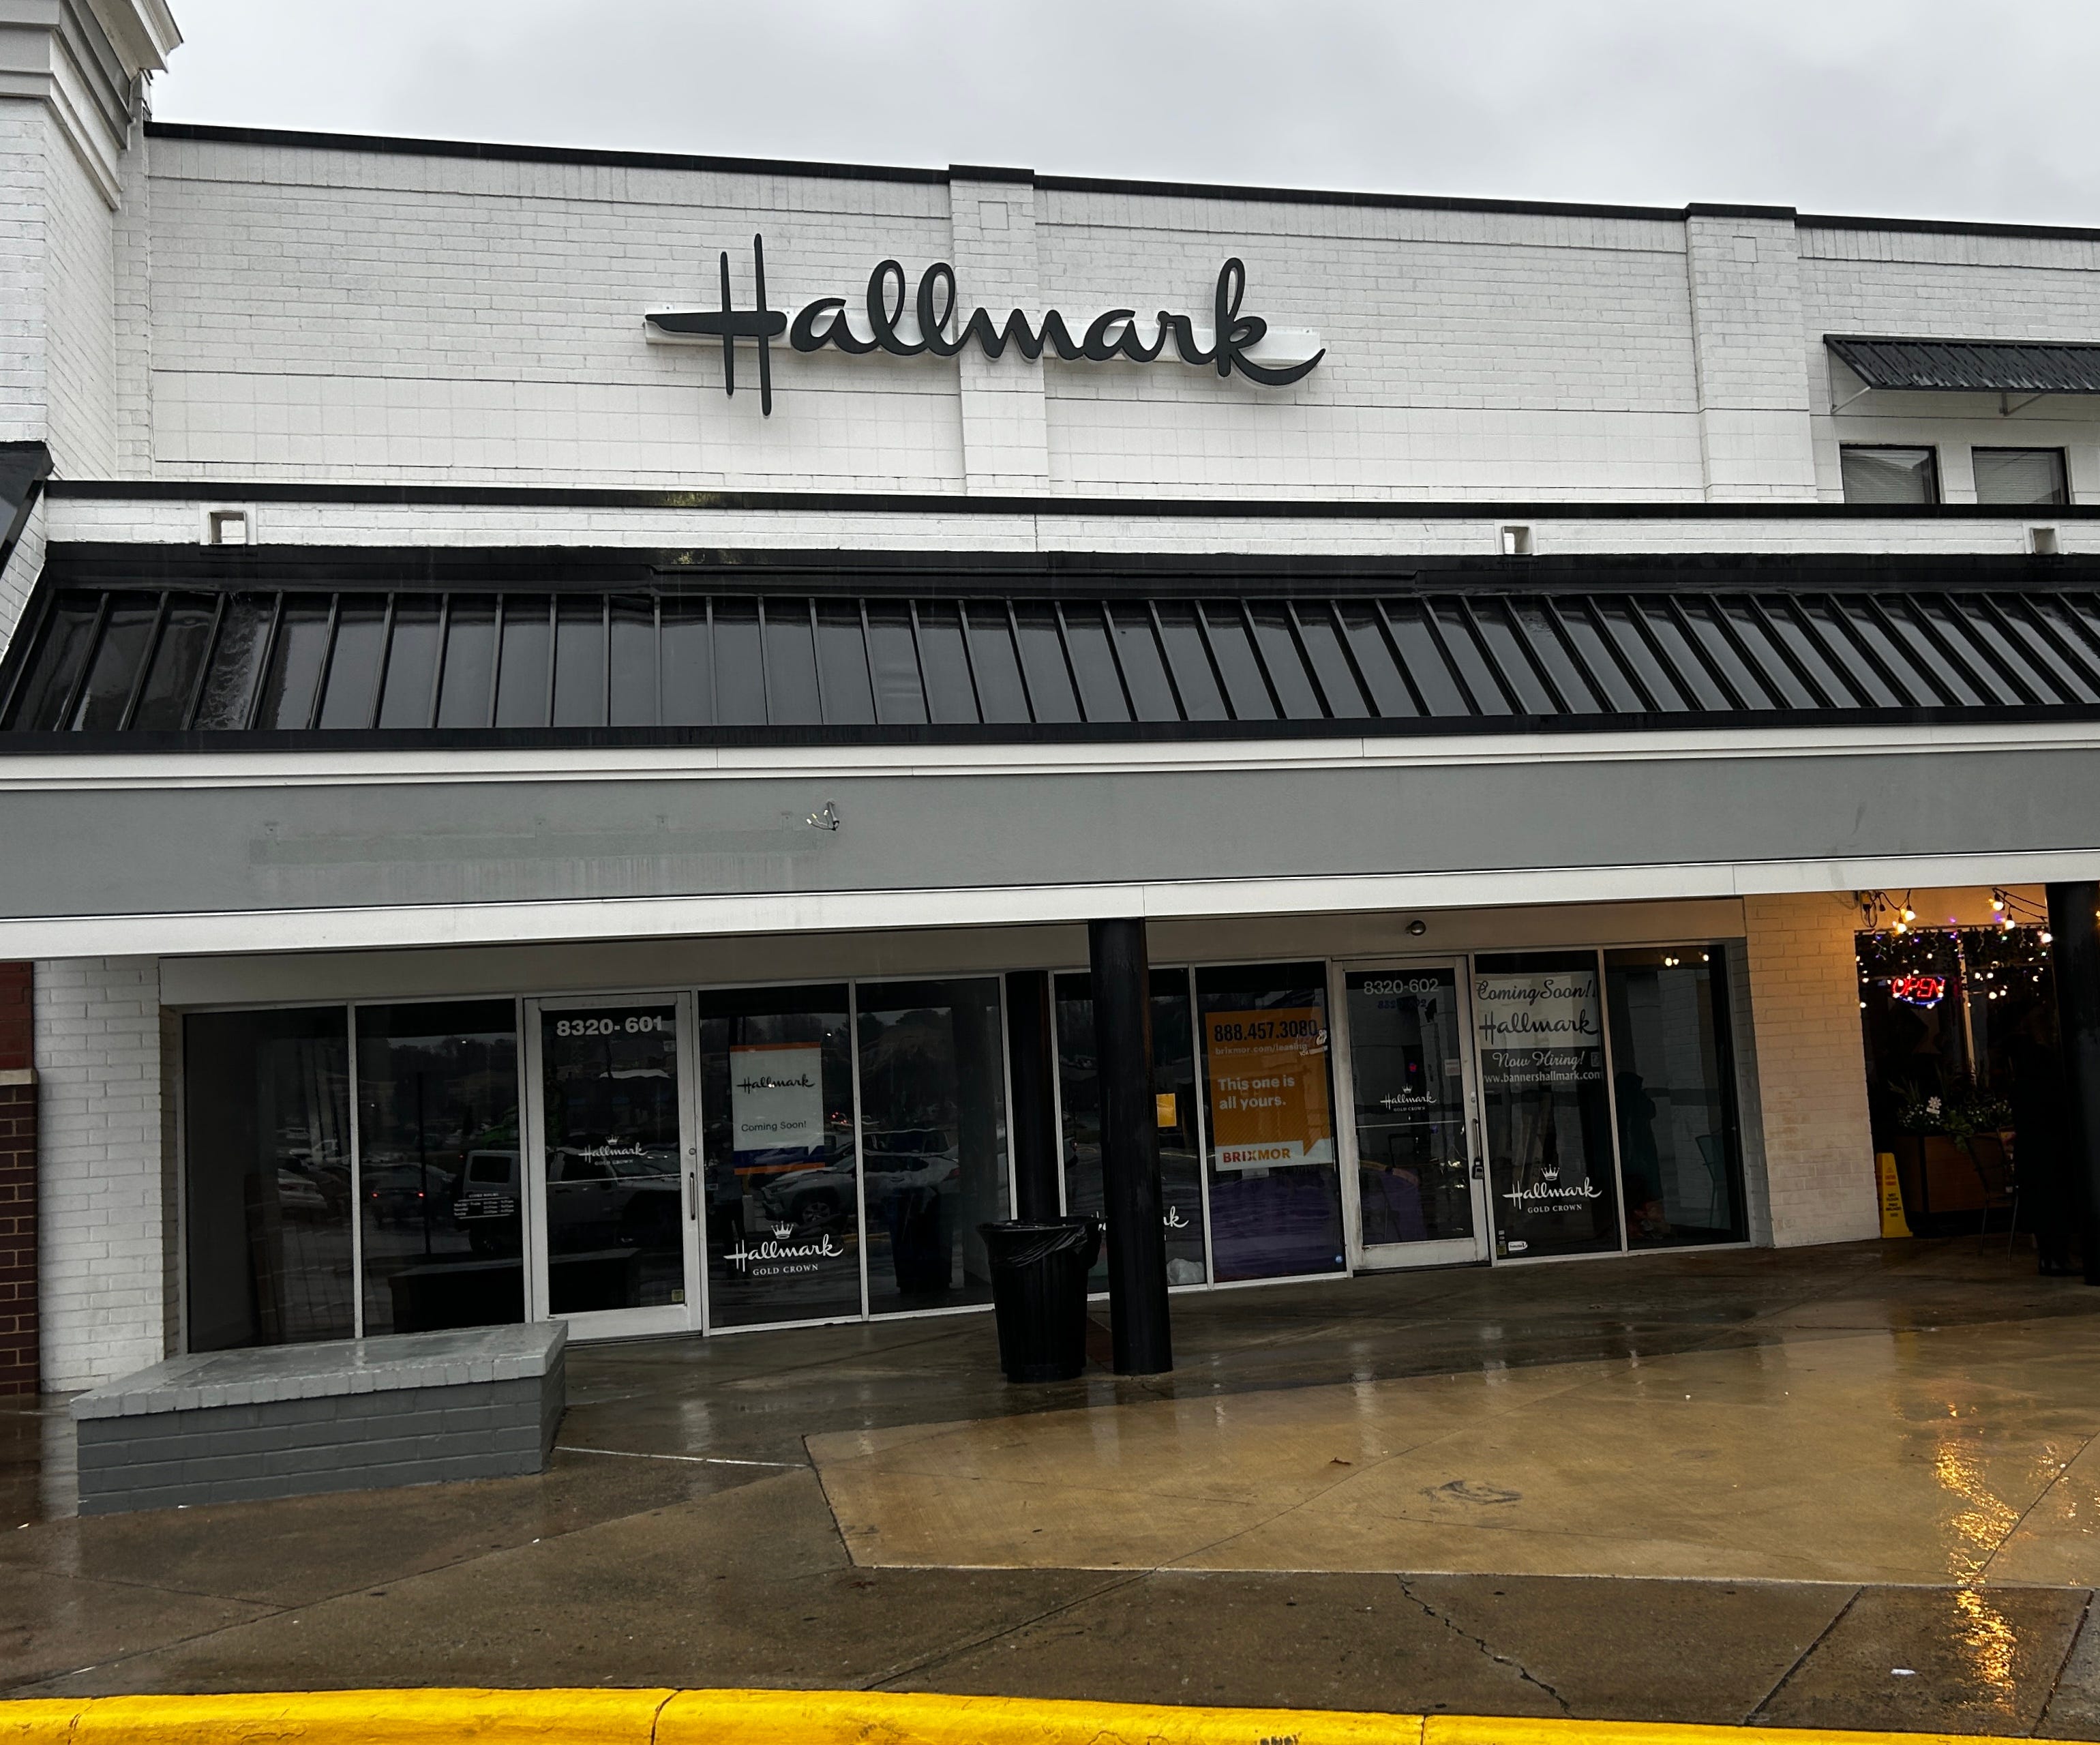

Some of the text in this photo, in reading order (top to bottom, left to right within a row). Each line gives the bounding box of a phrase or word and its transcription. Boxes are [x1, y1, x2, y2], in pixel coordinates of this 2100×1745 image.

[645, 233, 1325, 416] Hallmark
[1364, 979, 1439, 995] 8320-602
[1475, 980, 1540, 1006] Coming
[1892, 978, 1945, 998] OPEN
[1214, 1019, 1318, 1043] 888.457.3080
[1479, 1009, 1599, 1045] Hallmark
[1492, 1050, 1585, 1070] Now Hiring!
[737, 1073, 815, 1094] Hallmark
[1218, 1075, 1295, 1091] This one is
[1219, 1095, 1287, 1112] all yours.
[1380, 1091, 1437, 1110] Hallmark
[741, 1120, 807, 1133] Coming Soon!
[578, 1142, 648, 1163] Hallmark
[1222, 1148, 1291, 1163] BRIXMOR
[1501, 1177, 1603, 1210] Hallmark
[1527, 1204, 1582, 1213] GOLD CROWN
[723, 1234, 844, 1272] Hallmark
[753, 1264, 819, 1276] GOLD CROWN
